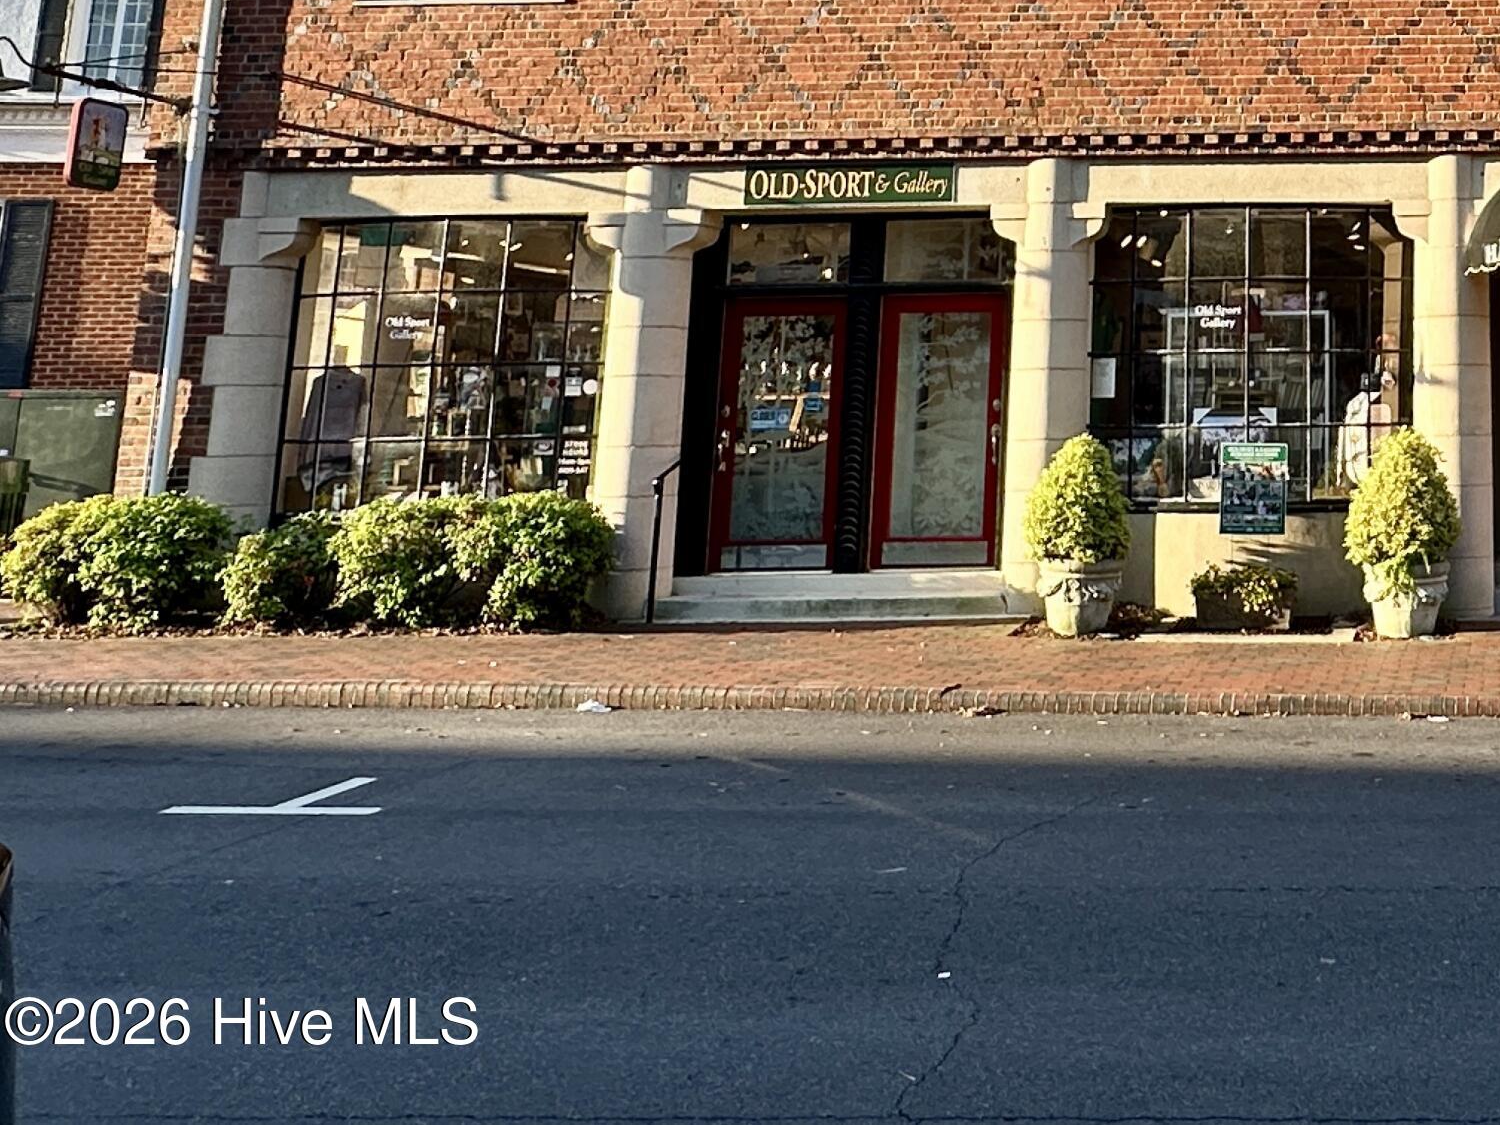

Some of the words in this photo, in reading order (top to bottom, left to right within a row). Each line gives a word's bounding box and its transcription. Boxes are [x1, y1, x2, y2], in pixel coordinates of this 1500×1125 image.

[750, 169, 874, 199] OLD-SPORT
[875, 174, 890, 194] &
[894, 170, 949, 198] Gallery
[1194, 304, 1213, 317] Old
[1214, 304, 1242, 317] Sport
[385, 315, 403, 328] Old
[404, 315, 430, 328] Sport
[1200, 317, 1236, 330] Gallery
[389, 329, 424, 342] Gallery
